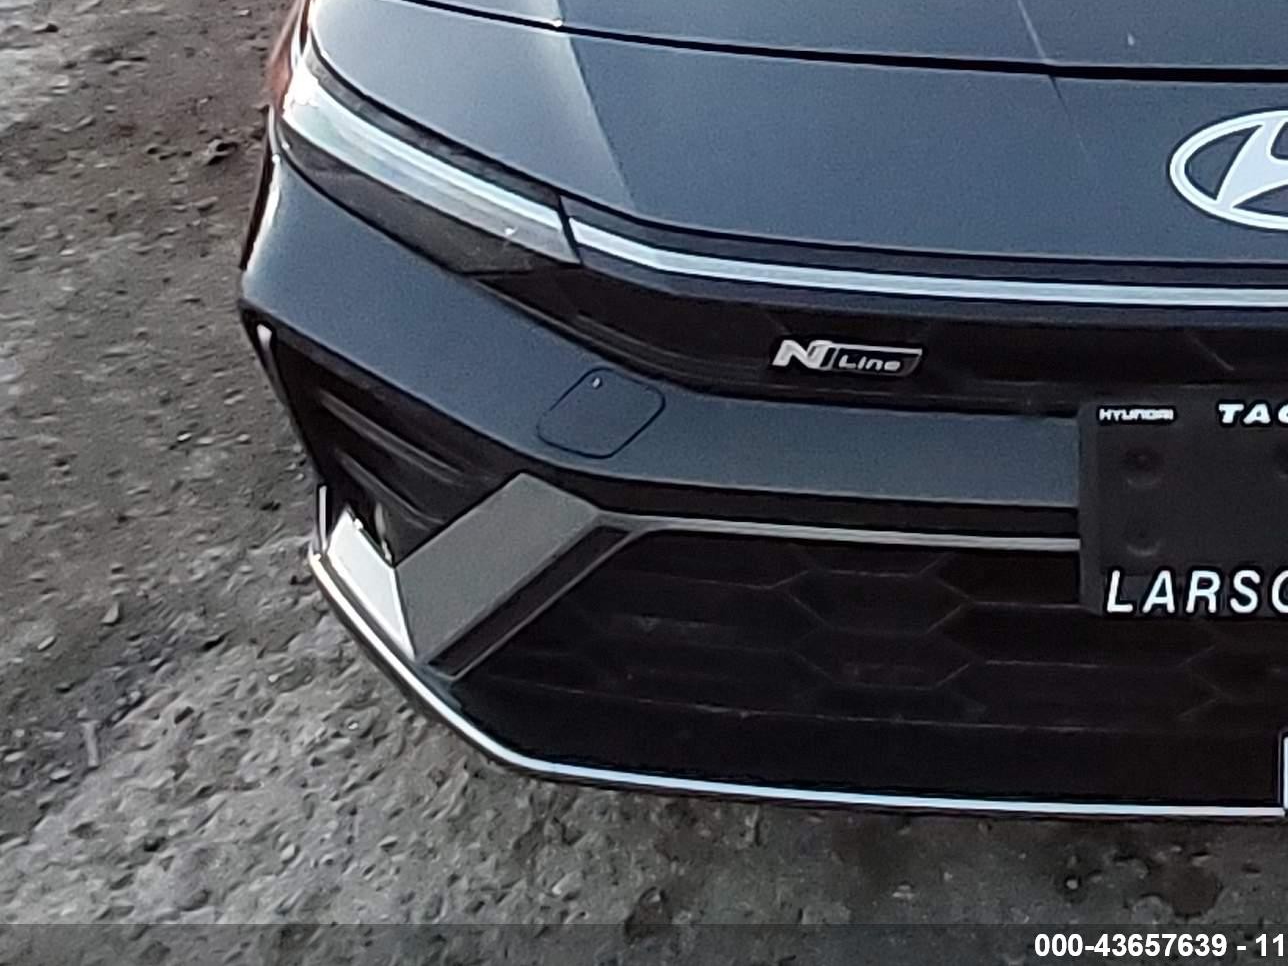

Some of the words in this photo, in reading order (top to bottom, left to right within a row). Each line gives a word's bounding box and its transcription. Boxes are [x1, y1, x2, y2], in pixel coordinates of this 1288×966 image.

[772, 339, 832, 370] N
[837, 354, 902, 372] Line
[1099, 408, 1175, 422] HYUNDAI
